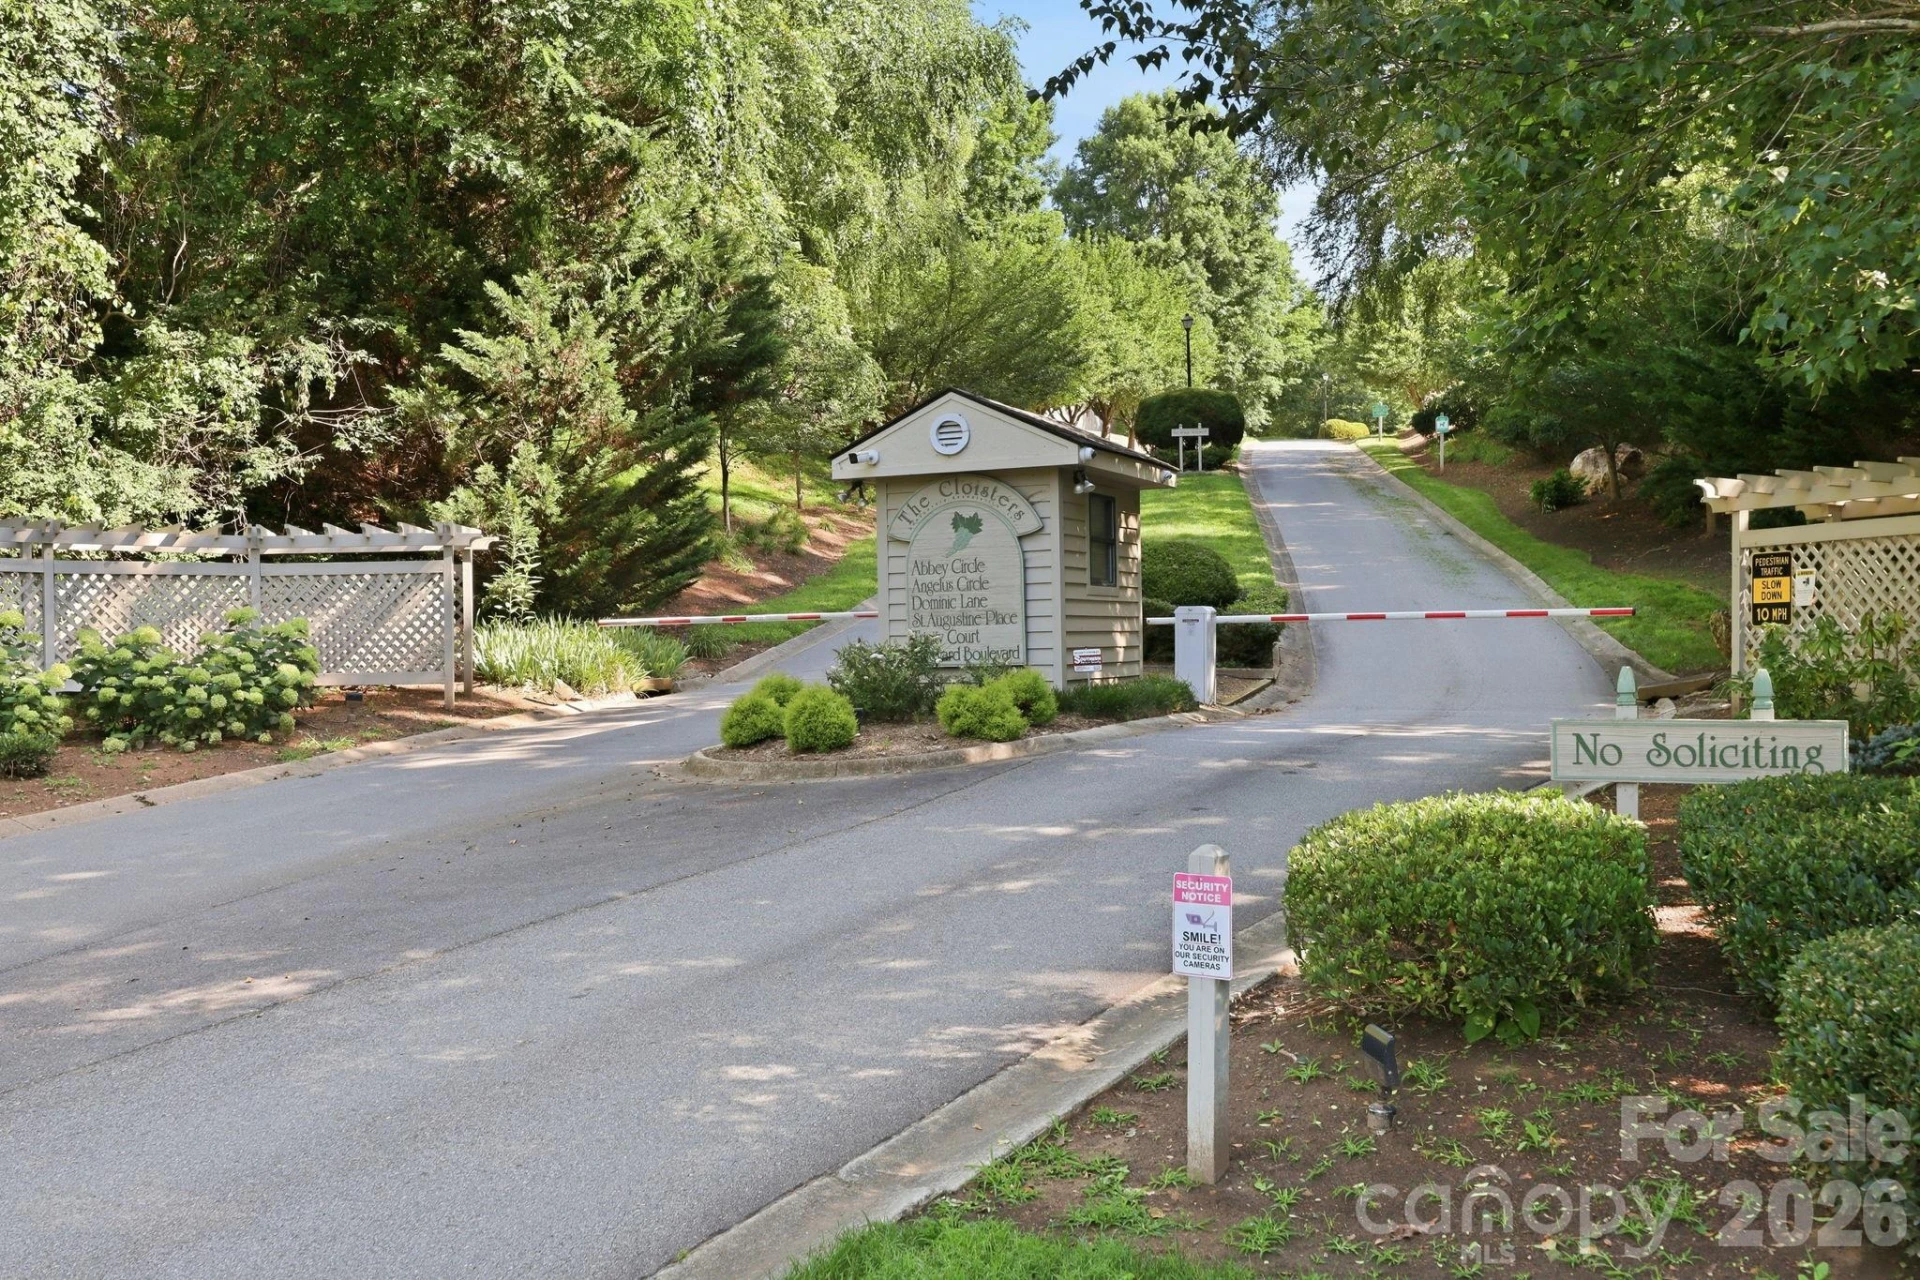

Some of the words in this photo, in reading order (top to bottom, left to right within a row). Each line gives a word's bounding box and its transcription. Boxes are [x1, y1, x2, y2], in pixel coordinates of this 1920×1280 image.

[898, 497, 930, 525] The
[938, 478, 1025, 521] Cloisters
[1755, 556, 1789, 566] PEDESTRIAN
[911, 560, 948, 579] Abbey
[951, 557, 985, 574] Circle
[1761, 567, 1783, 576] TRAFFIC
[912, 578, 953, 596] Angelus
[956, 575, 989, 592] Circle
[1762, 580, 1782, 589] SLOW
[912, 595, 956, 610] Dominic
[960, 593, 988, 609] Lane
[1761, 591, 1782, 600] DOWN
[927, 611, 981, 631] Augustine
[985, 610, 1018, 626] Place
[1757, 608, 1769, 621] 10
[1772, 608, 1787, 620] MPH
[947, 629, 980, 645] Court
[963, 645, 1020, 662] Boulevard
[1572, 732, 1623, 766] No
[1646, 732, 1825, 774] Soliciting
[1176, 880, 1229, 892] SECURITY
[1182, 892, 1221, 903] NOTICE
[1183, 931, 1221, 944] SMILE!
[1179, 943, 1194, 951] YOU
[1196, 945, 1211, 953] ARE
[1214, 946, 1225, 954] ON
[1175, 951, 1190, 959] OUR
[1193, 952, 1229, 963] SECURITY
[1184, 960, 1220, 970] CAMERAS
